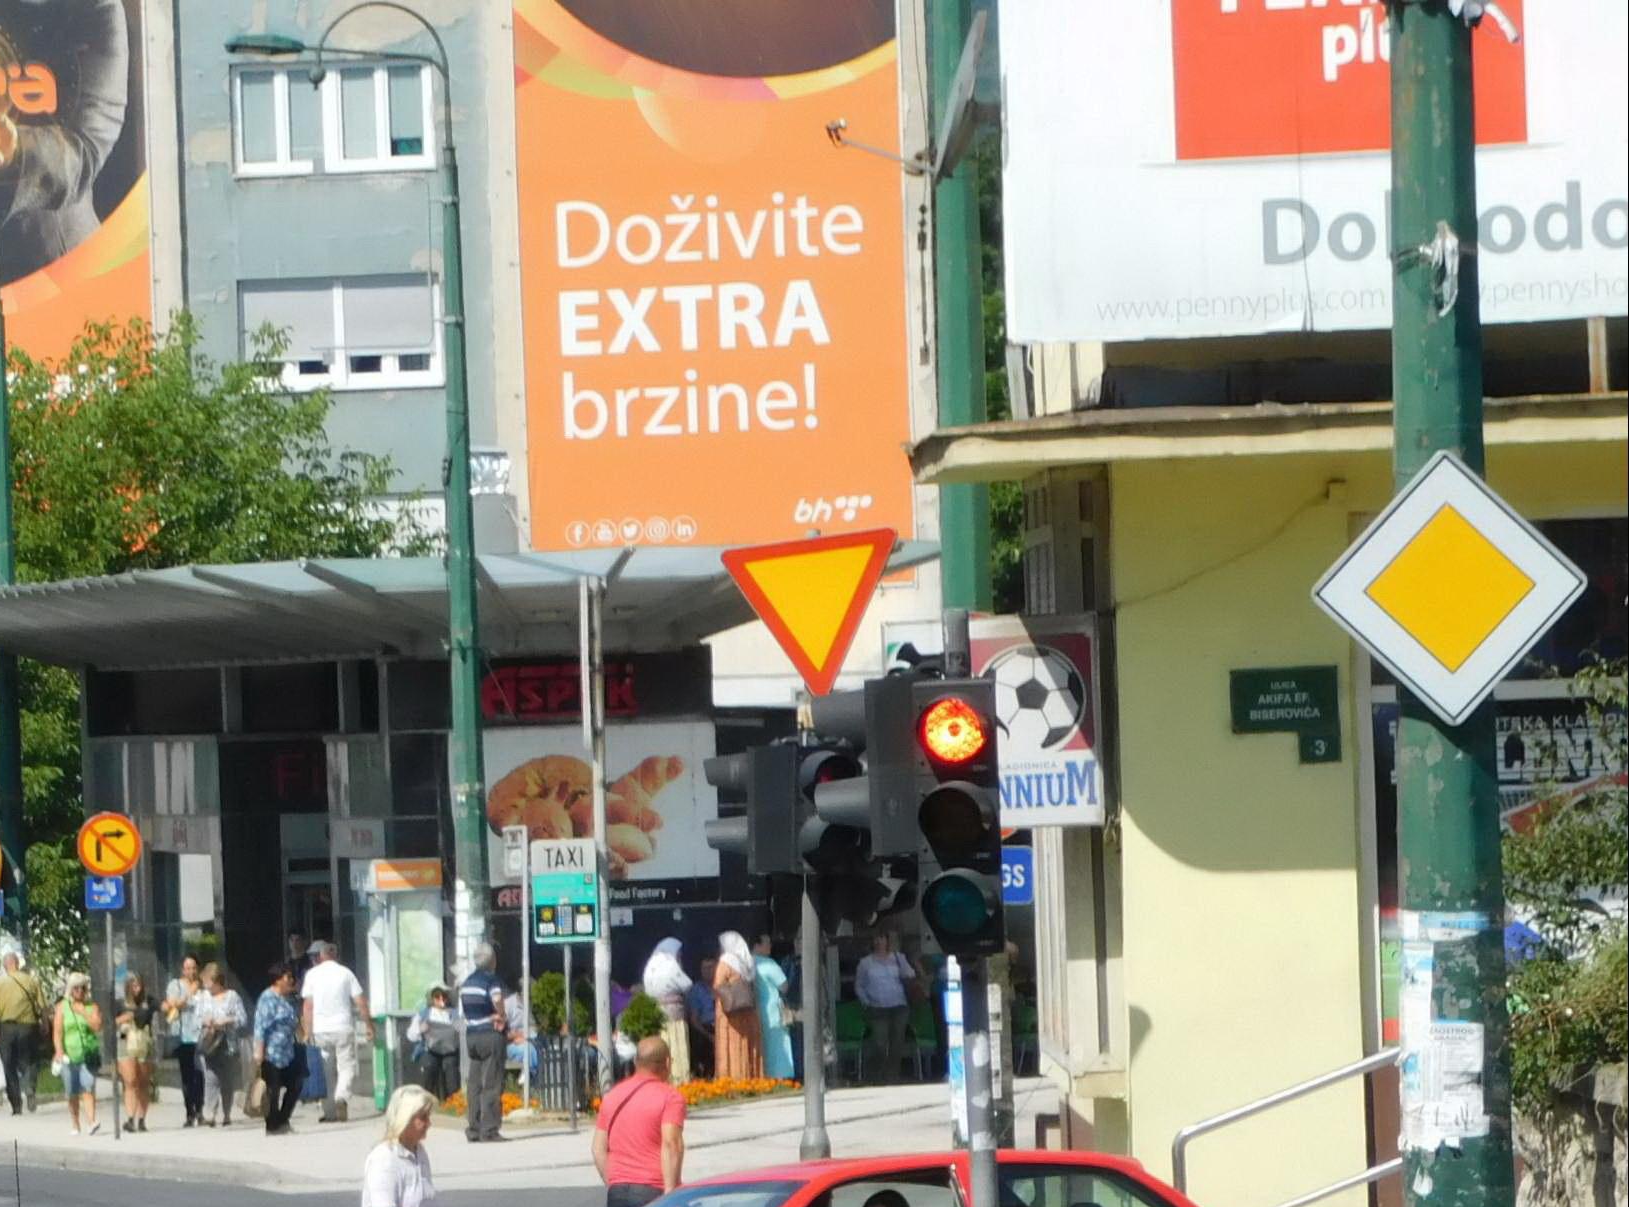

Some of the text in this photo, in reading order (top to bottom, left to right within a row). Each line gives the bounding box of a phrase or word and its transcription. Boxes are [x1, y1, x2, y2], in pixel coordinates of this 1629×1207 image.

[1322, 8, 1391, 82] pl
[556, 192, 864, 268] Doživite
[1262, 180, 1628, 267] Doodo
[558, 279, 831, 357] EXTRA
[1096, 272, 1628, 323] www.pennyplus.com .pennysho
[562, 363, 819, 440] brzine!
[1258, 694, 1291, 705] AKIFA
[1314, 739, 1326, 755] 3
[999, 759, 1098, 810] NNIUM
[545, 846, 584, 868] TAXI
[1002, 863, 1025, 888] GS
